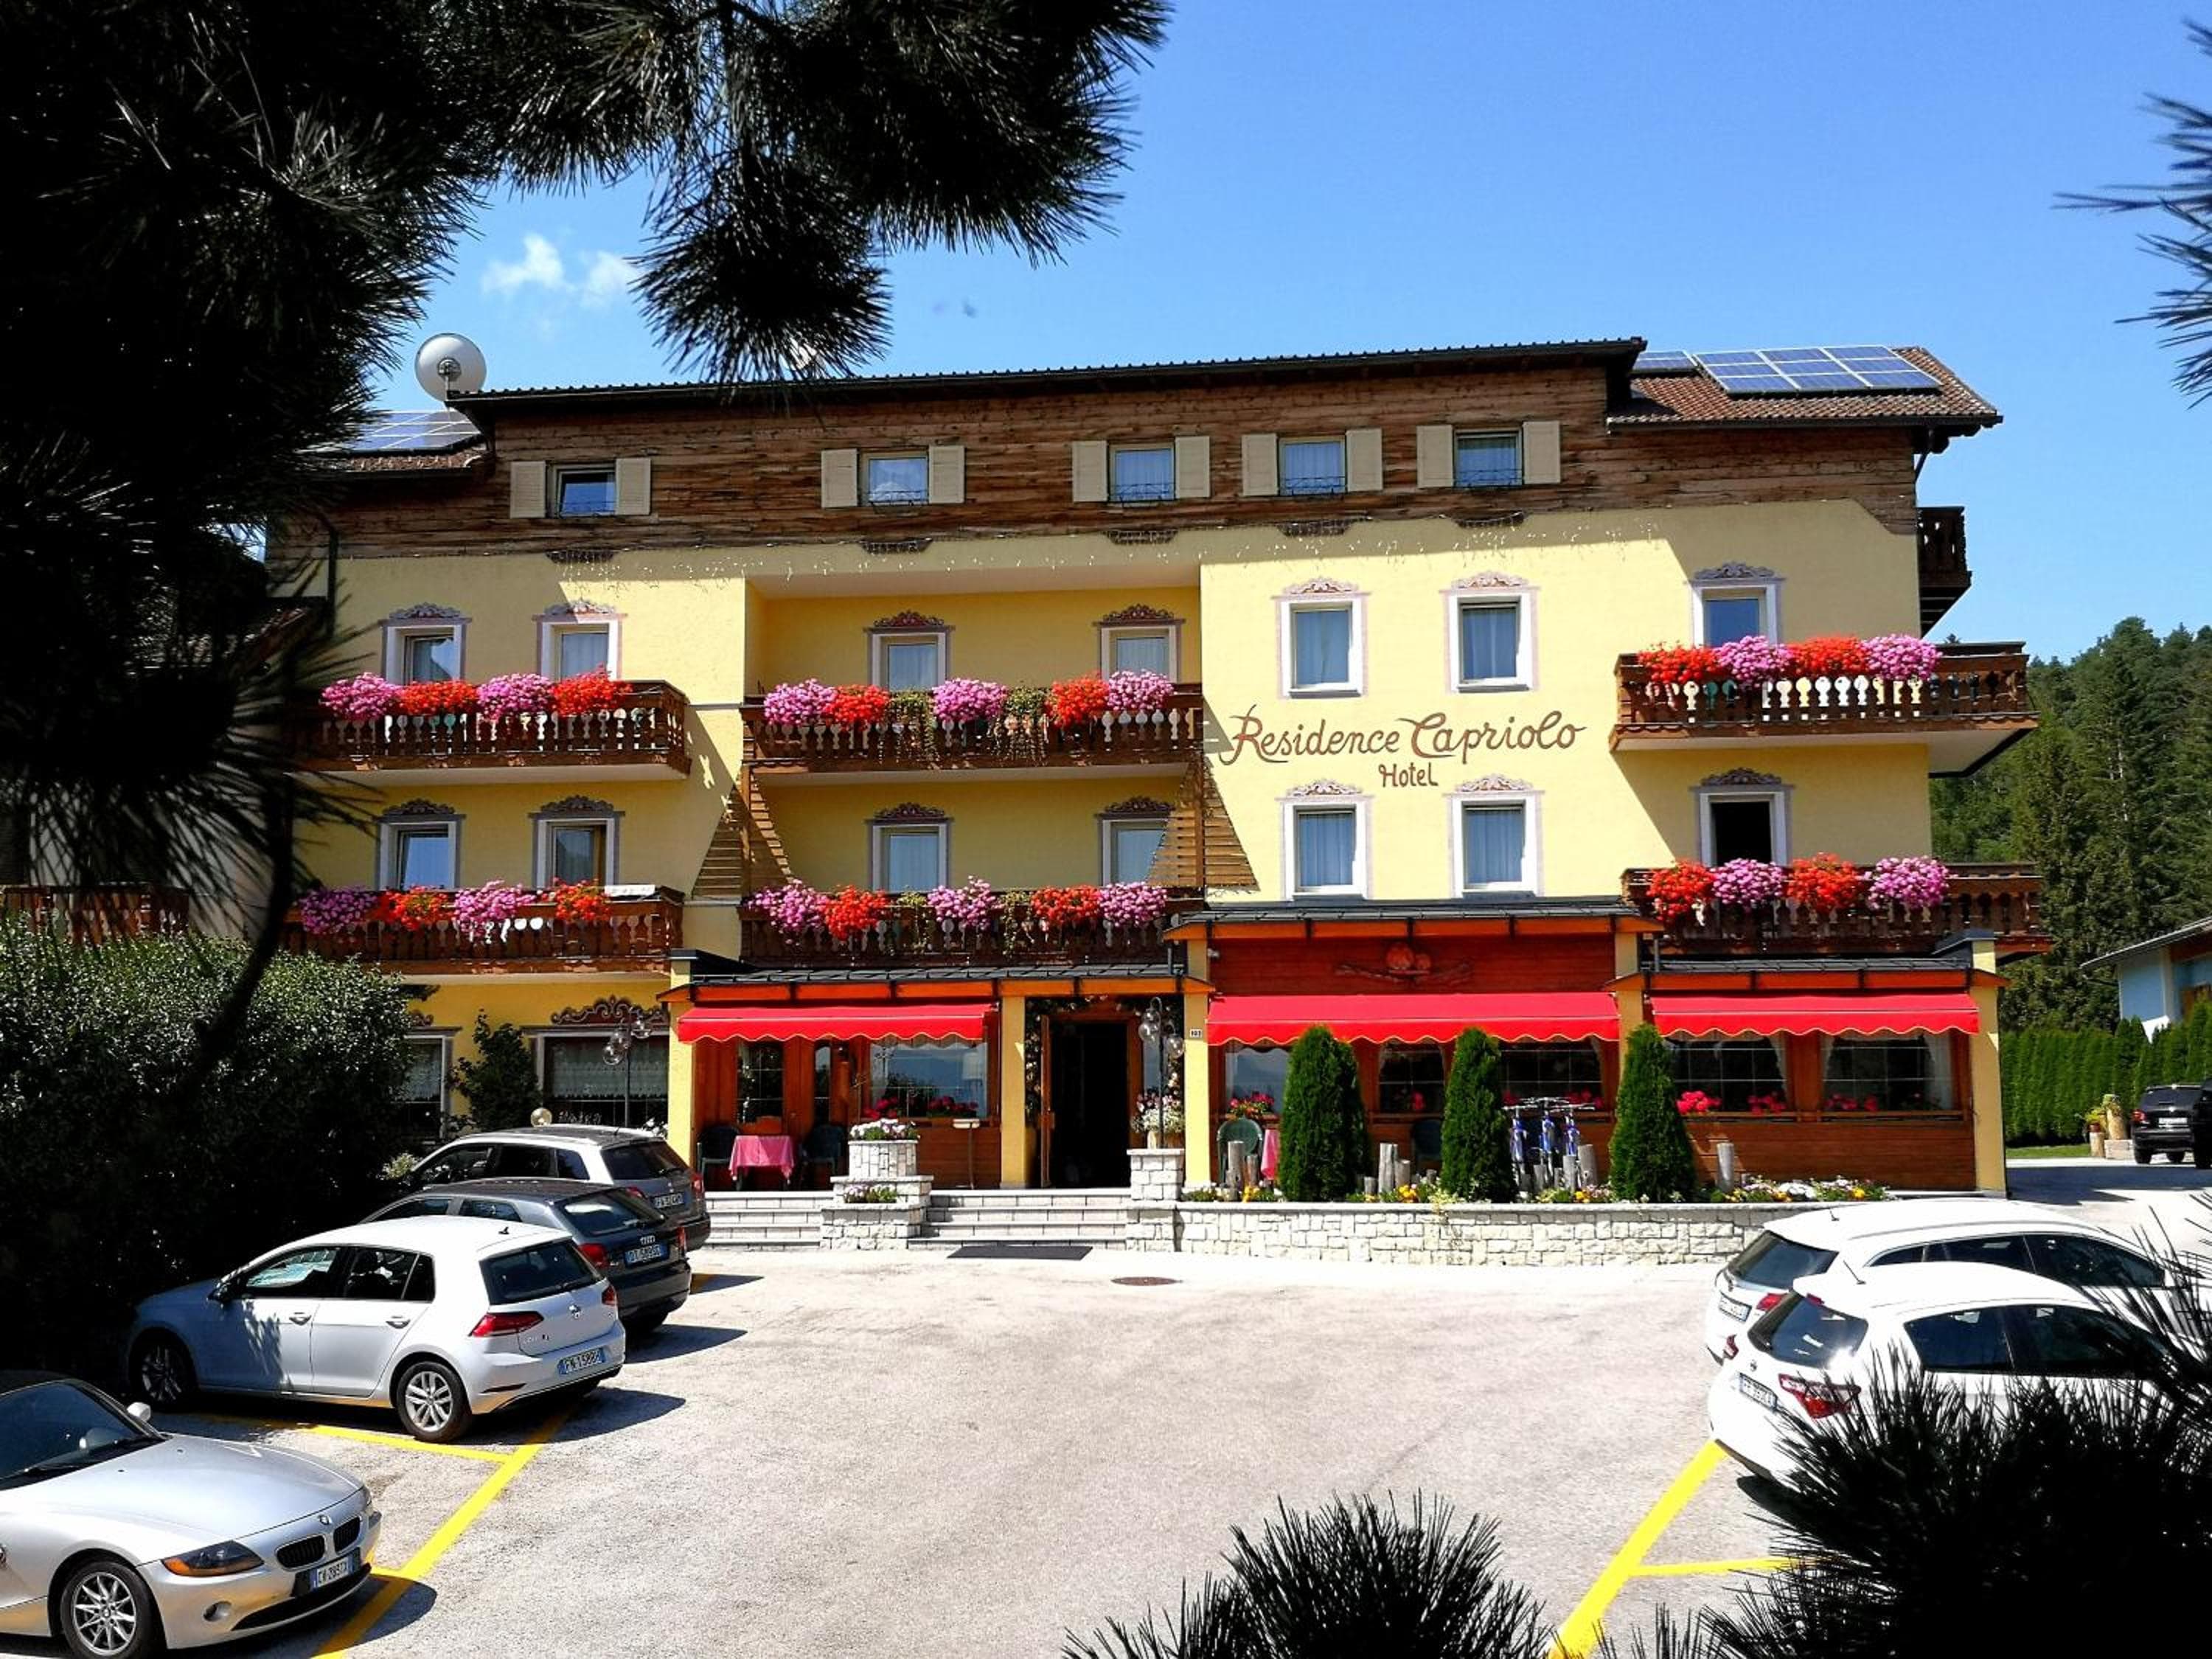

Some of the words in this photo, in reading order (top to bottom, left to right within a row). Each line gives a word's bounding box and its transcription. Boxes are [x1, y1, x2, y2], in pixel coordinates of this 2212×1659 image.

[1218, 704, 1400, 766] Residence
[1396, 710, 1587, 765] Capriolo
[1378, 762, 1439, 788] Hotel
